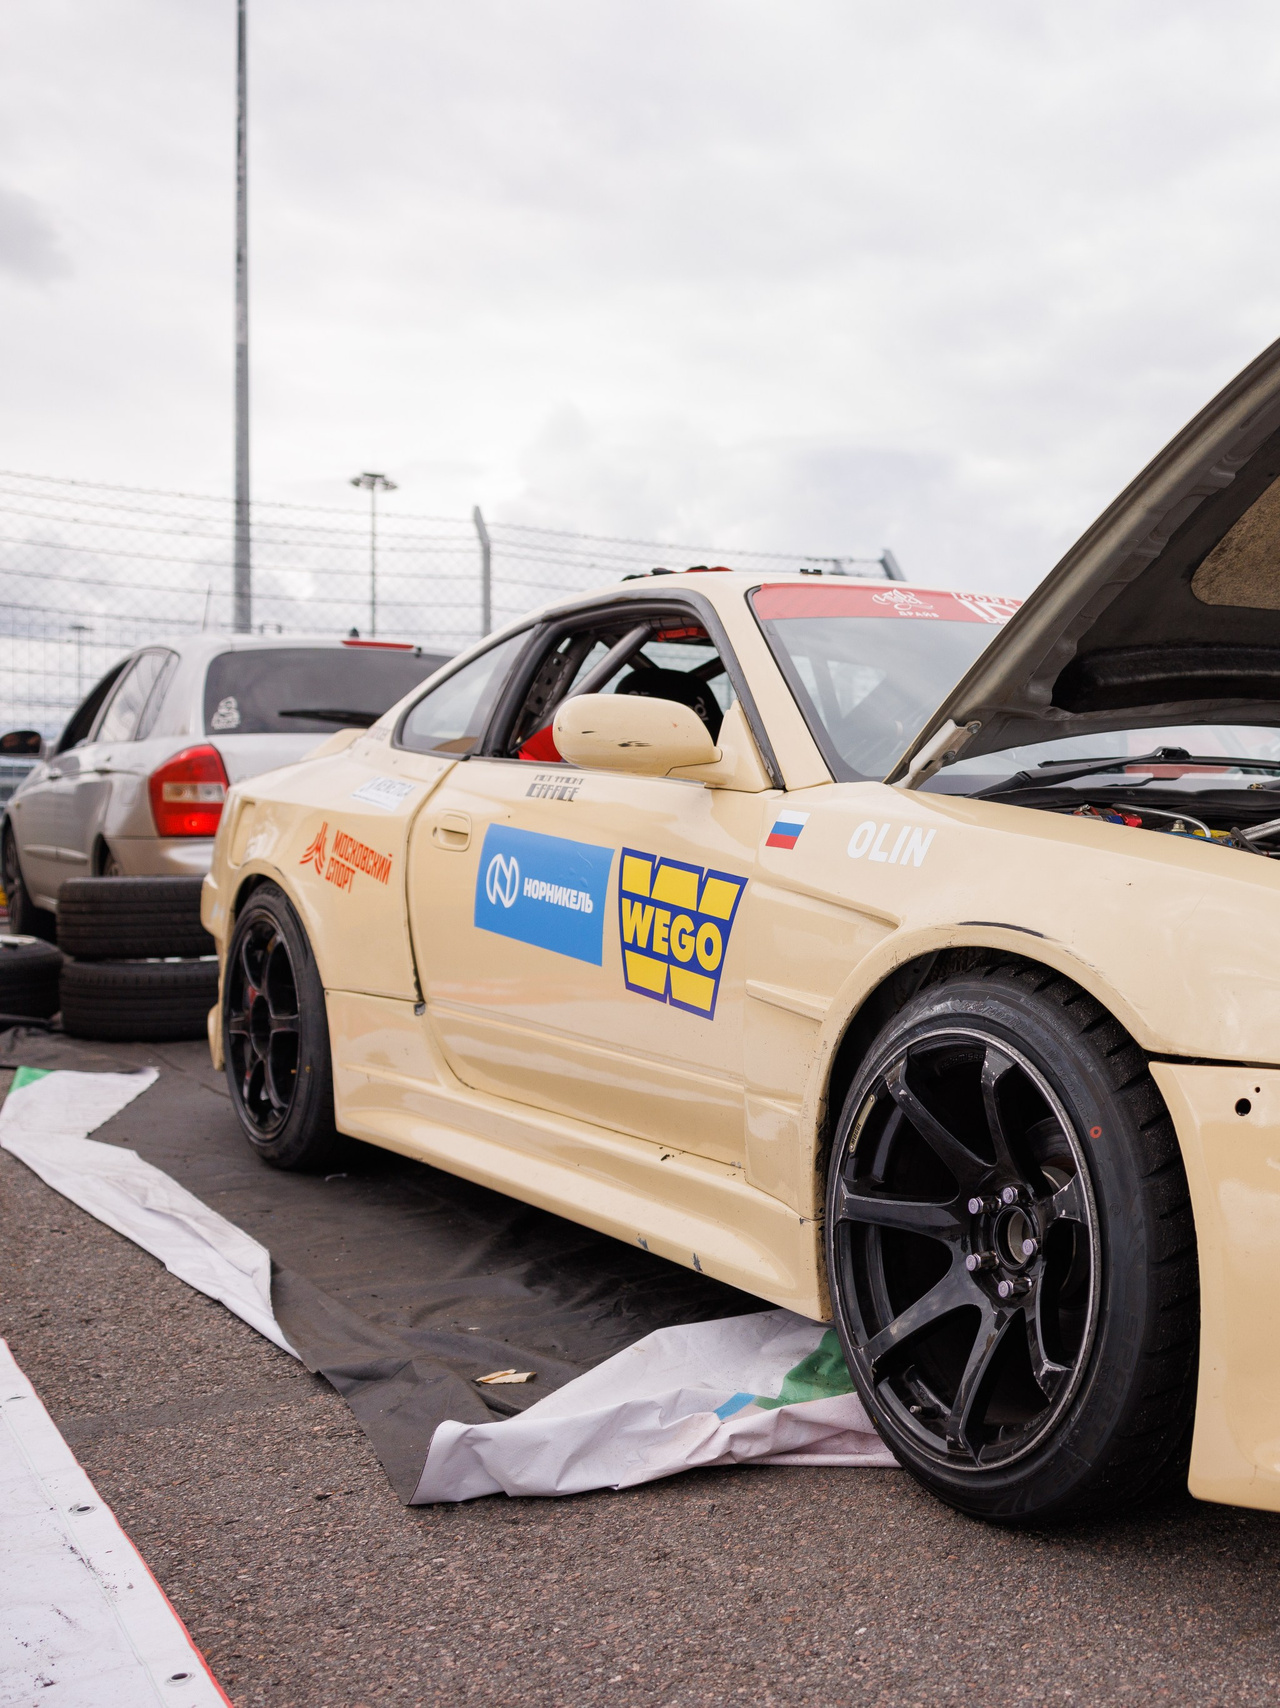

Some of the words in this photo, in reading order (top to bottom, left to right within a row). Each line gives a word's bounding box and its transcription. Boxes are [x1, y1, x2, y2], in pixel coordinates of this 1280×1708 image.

[331, 829, 393, 886] МОСКОВСКИЙ
[846, 820, 938, 868] OLIN
[325, 856, 356, 894] СПОРТ
[523, 877, 594, 914] НОРНИКЕЛЬ
[621, 897, 723, 972] WEGO
